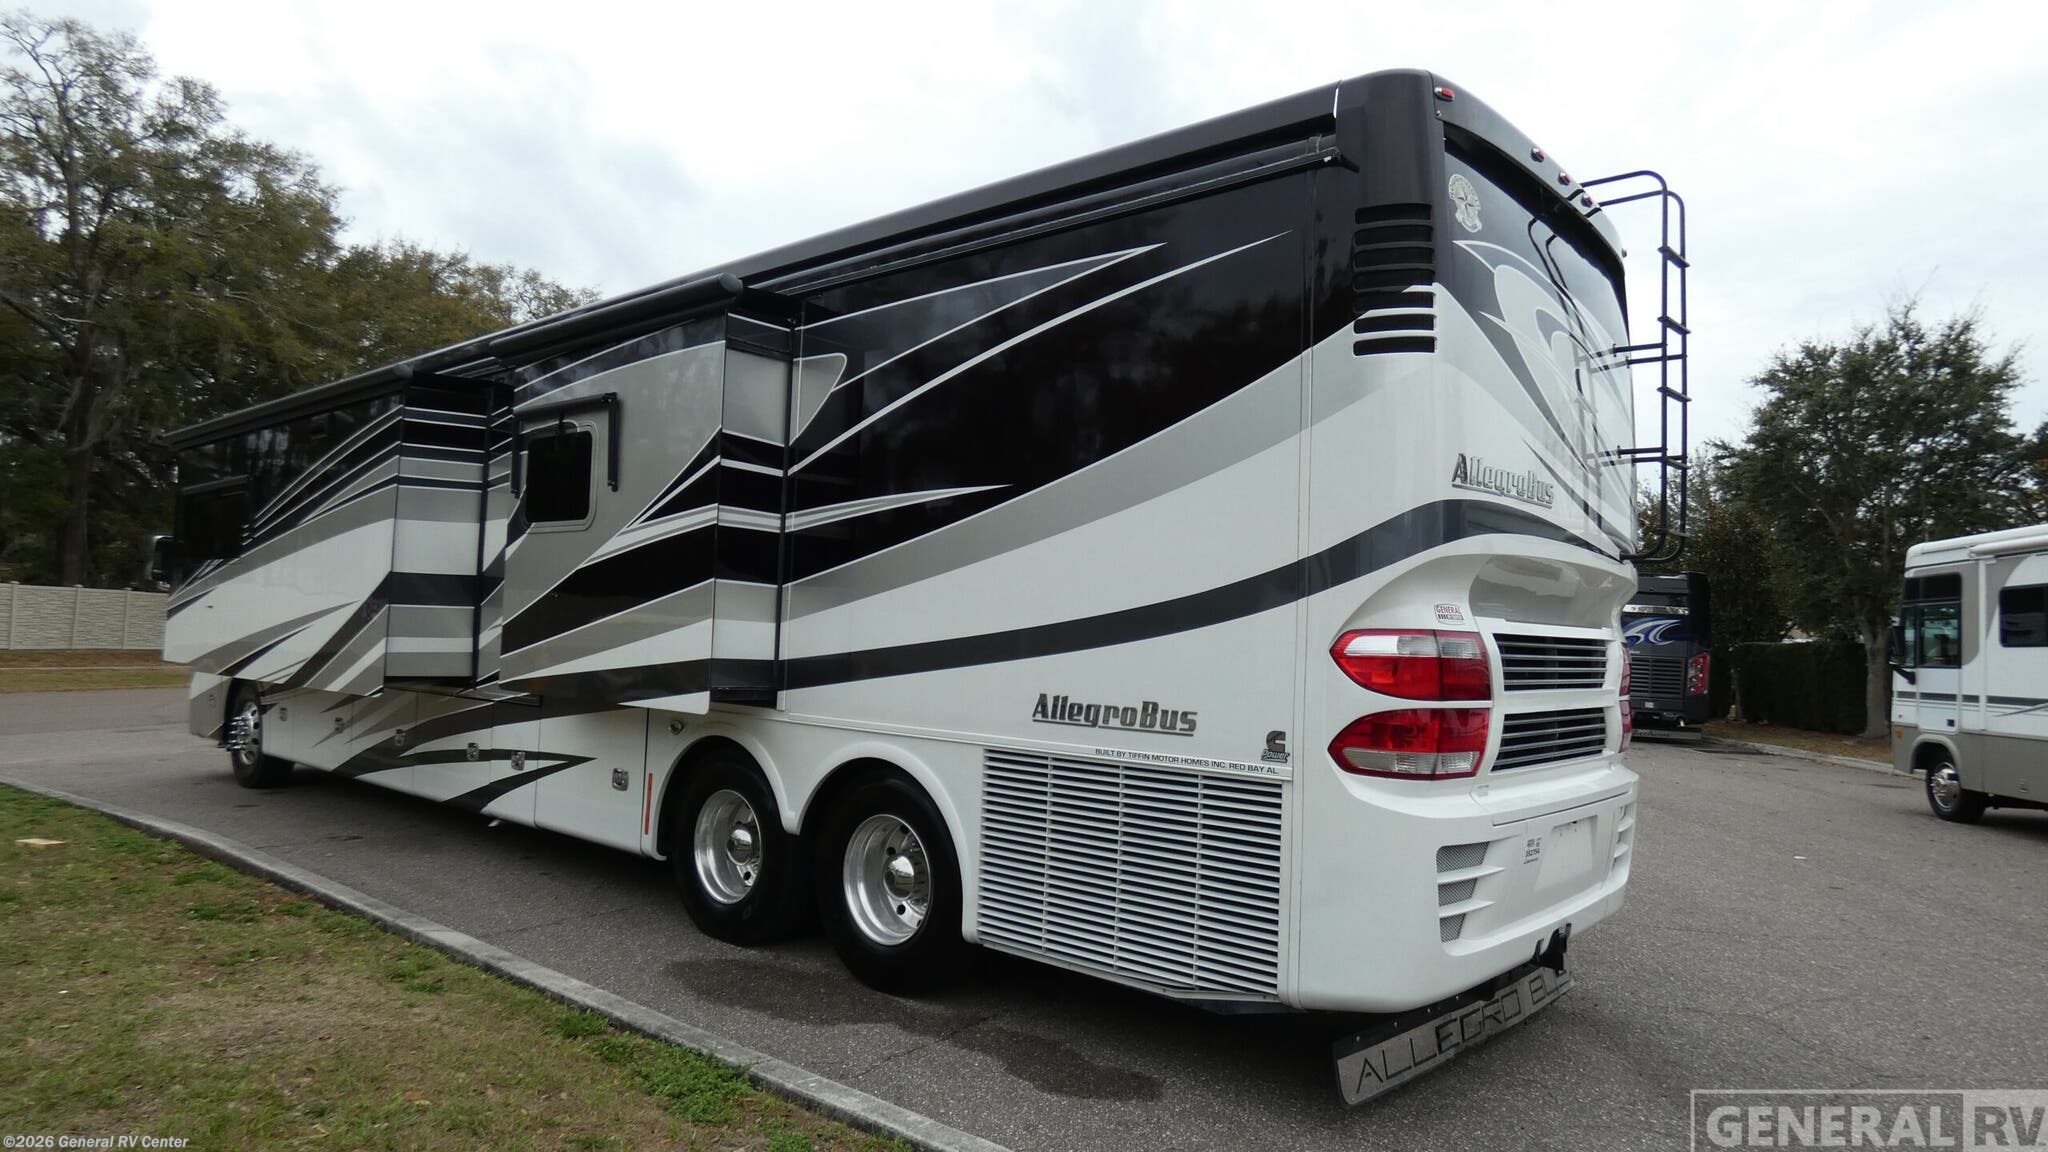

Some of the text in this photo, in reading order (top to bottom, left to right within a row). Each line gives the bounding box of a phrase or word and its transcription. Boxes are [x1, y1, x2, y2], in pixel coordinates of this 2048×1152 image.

[1032, 693, 1198, 733] AllegroBus
[1095, 748, 1115, 757] BUILT
[1116, 750, 1127, 758] BY
[1128, 751, 1150, 760] TIFFIN
[1151, 754, 1179, 763] MOTOR
[1180, 757, 1210, 767] HOMES
[1229, 762, 1246, 771] RED
[1247, 764, 1265, 773] BAY
[1356, 988, 1522, 1094] ALLEGRO
